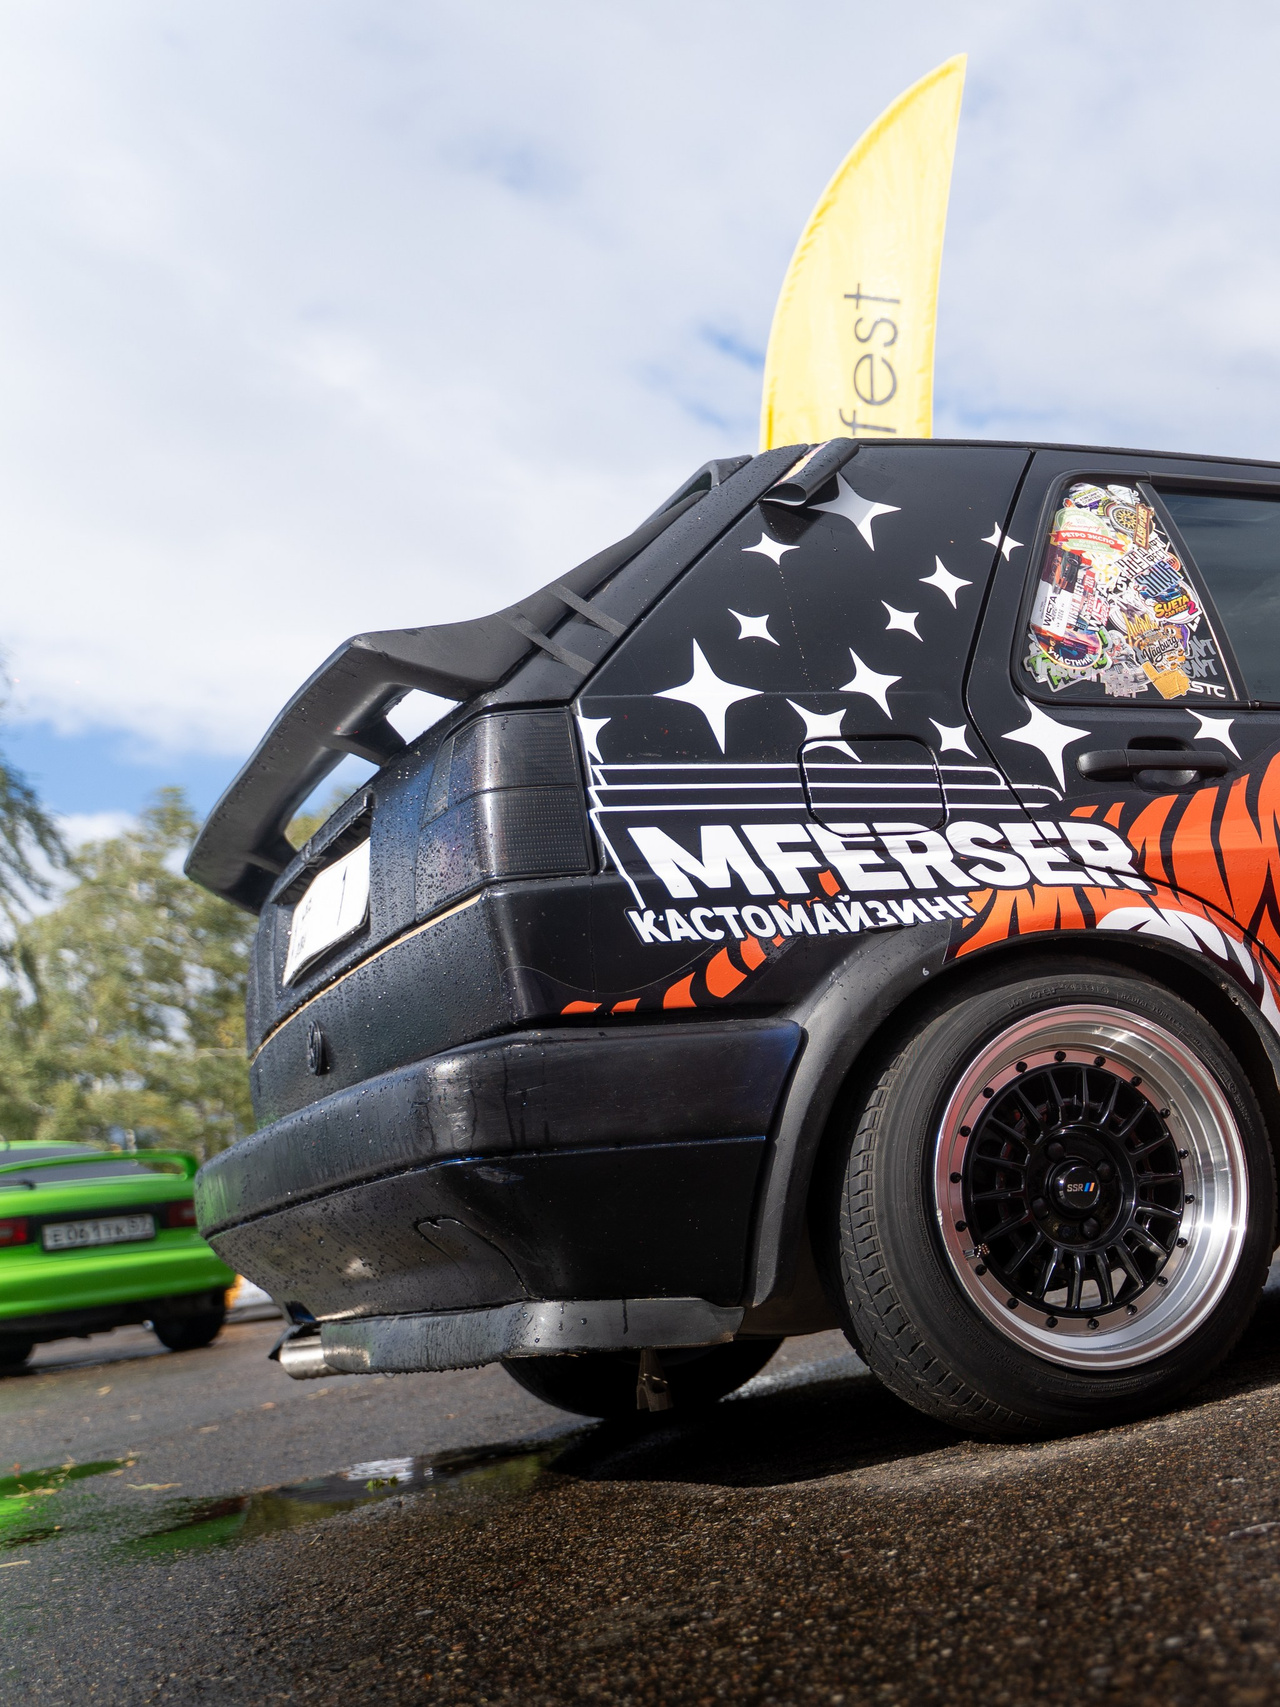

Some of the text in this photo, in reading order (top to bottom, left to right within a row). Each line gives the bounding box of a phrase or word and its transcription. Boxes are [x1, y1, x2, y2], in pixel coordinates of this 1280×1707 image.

[839, 283, 900, 436] fest
[1087, 533, 1115, 545] ЭКСПО
[1043, 596, 1057, 627] WISTA
[1154, 595, 1190, 619] SUETA
[1187, 601, 1198, 615] 2
[1047, 648, 1093, 666] УЧАСТНИК
[627, 820, 1160, 899] MFERSER
[627, 893, 977, 944] КАСТОМАЙЗИНГ
[1066, 1183, 1084, 1192] SSR
